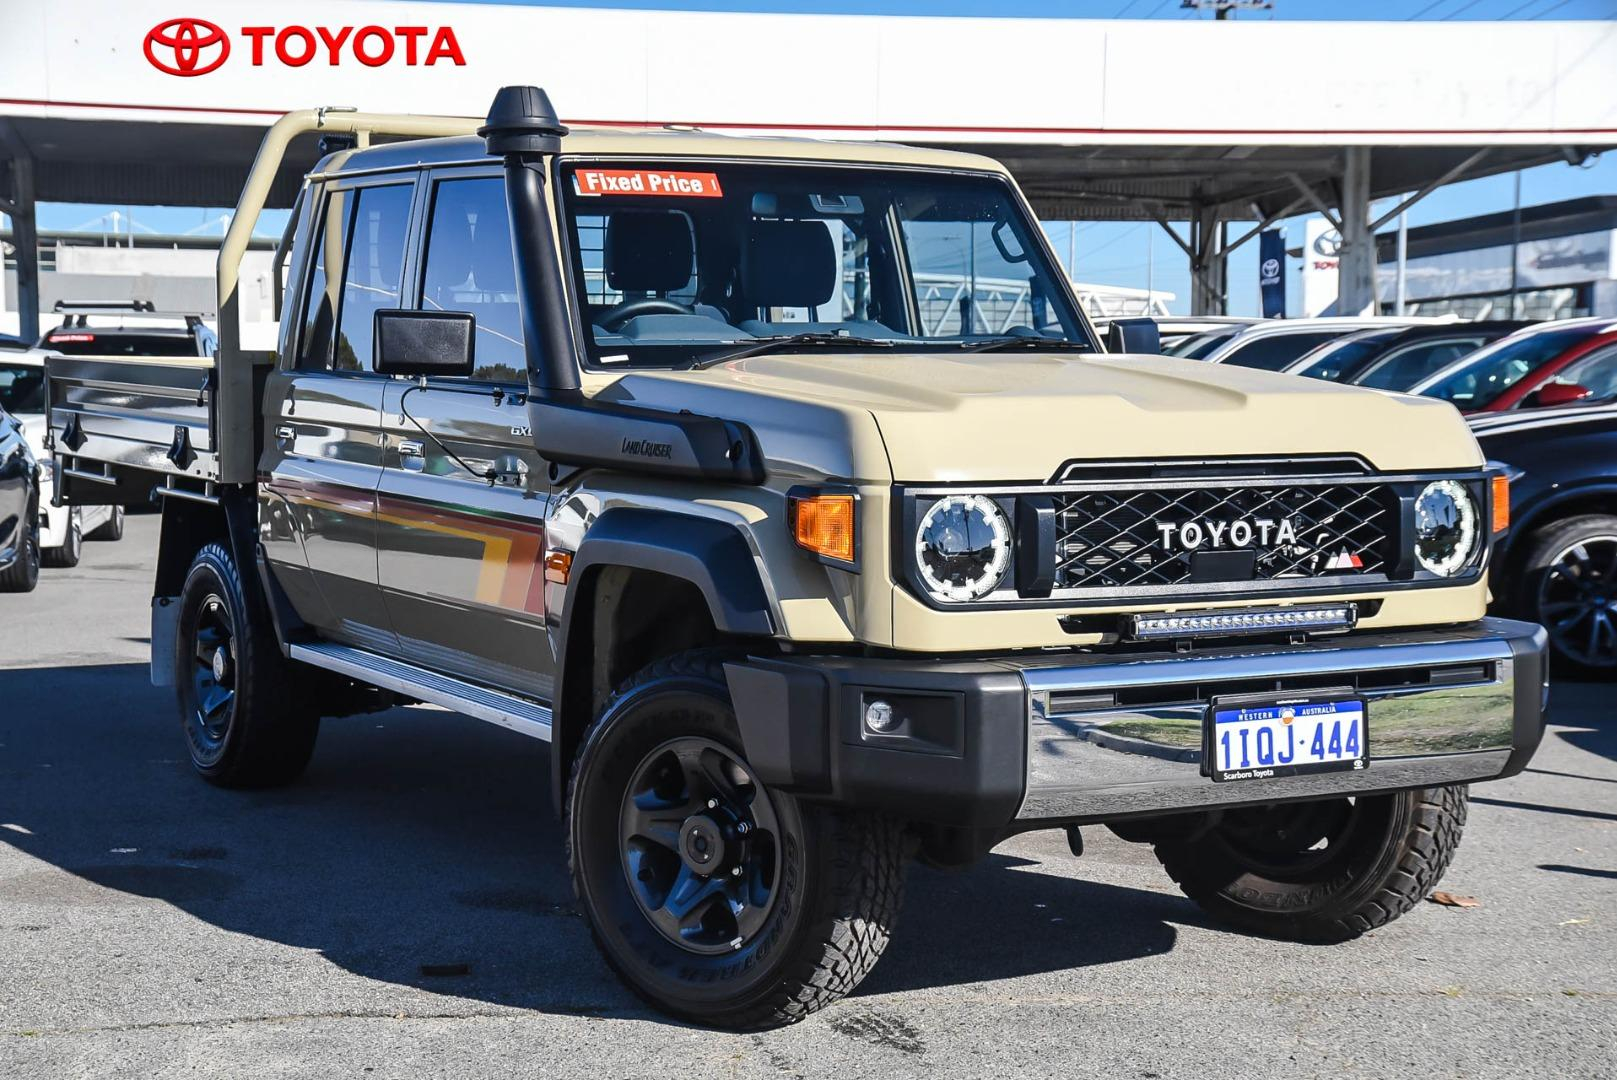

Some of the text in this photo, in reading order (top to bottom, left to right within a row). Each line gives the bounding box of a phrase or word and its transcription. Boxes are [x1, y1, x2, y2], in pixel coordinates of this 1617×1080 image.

[241, 25, 467, 67] TOYOTA
[585, 172, 704, 193] Fixed Price
[1156, 518, 1297, 549] TOYOTA
[1238, 706, 1337, 721] WESTERN AUSTRALIA
[1223, 769, 1274, 780] Scarboro Toyota
